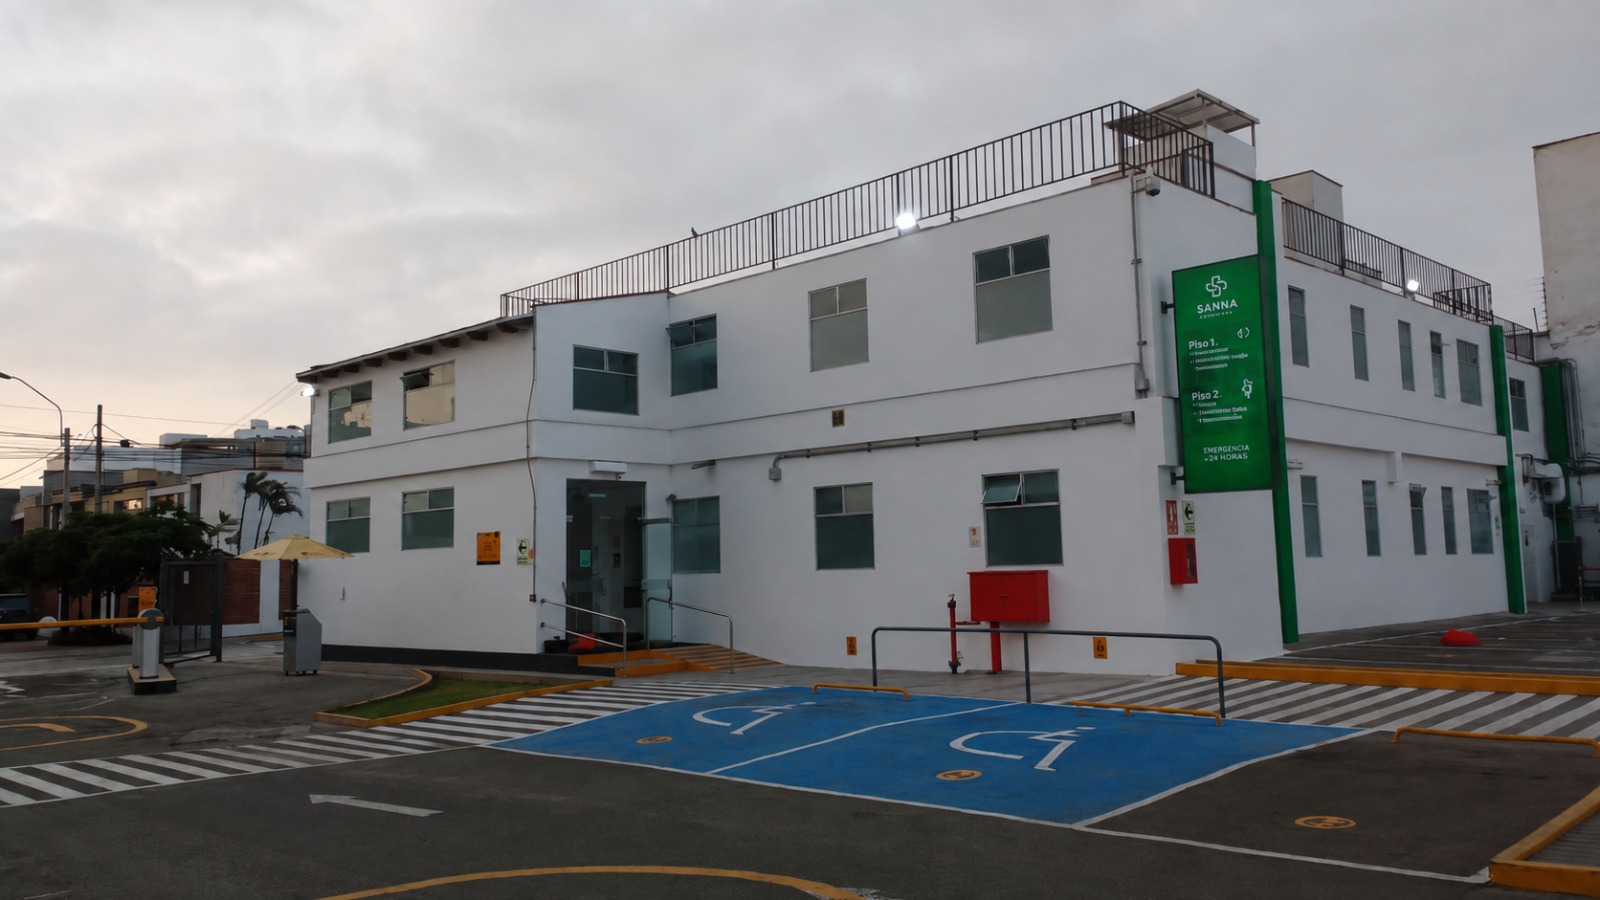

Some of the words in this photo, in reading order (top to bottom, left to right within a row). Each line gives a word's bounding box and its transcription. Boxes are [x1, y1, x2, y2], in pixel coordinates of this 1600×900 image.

[1197, 299, 1238, 314] SANNA
[1188, 339, 1209, 350] Piso
[1191, 391, 1212, 401] Piso
[1203, 444, 1250, 454] EMERGENCIA
[1220, 452, 1248, 461] HORAS
